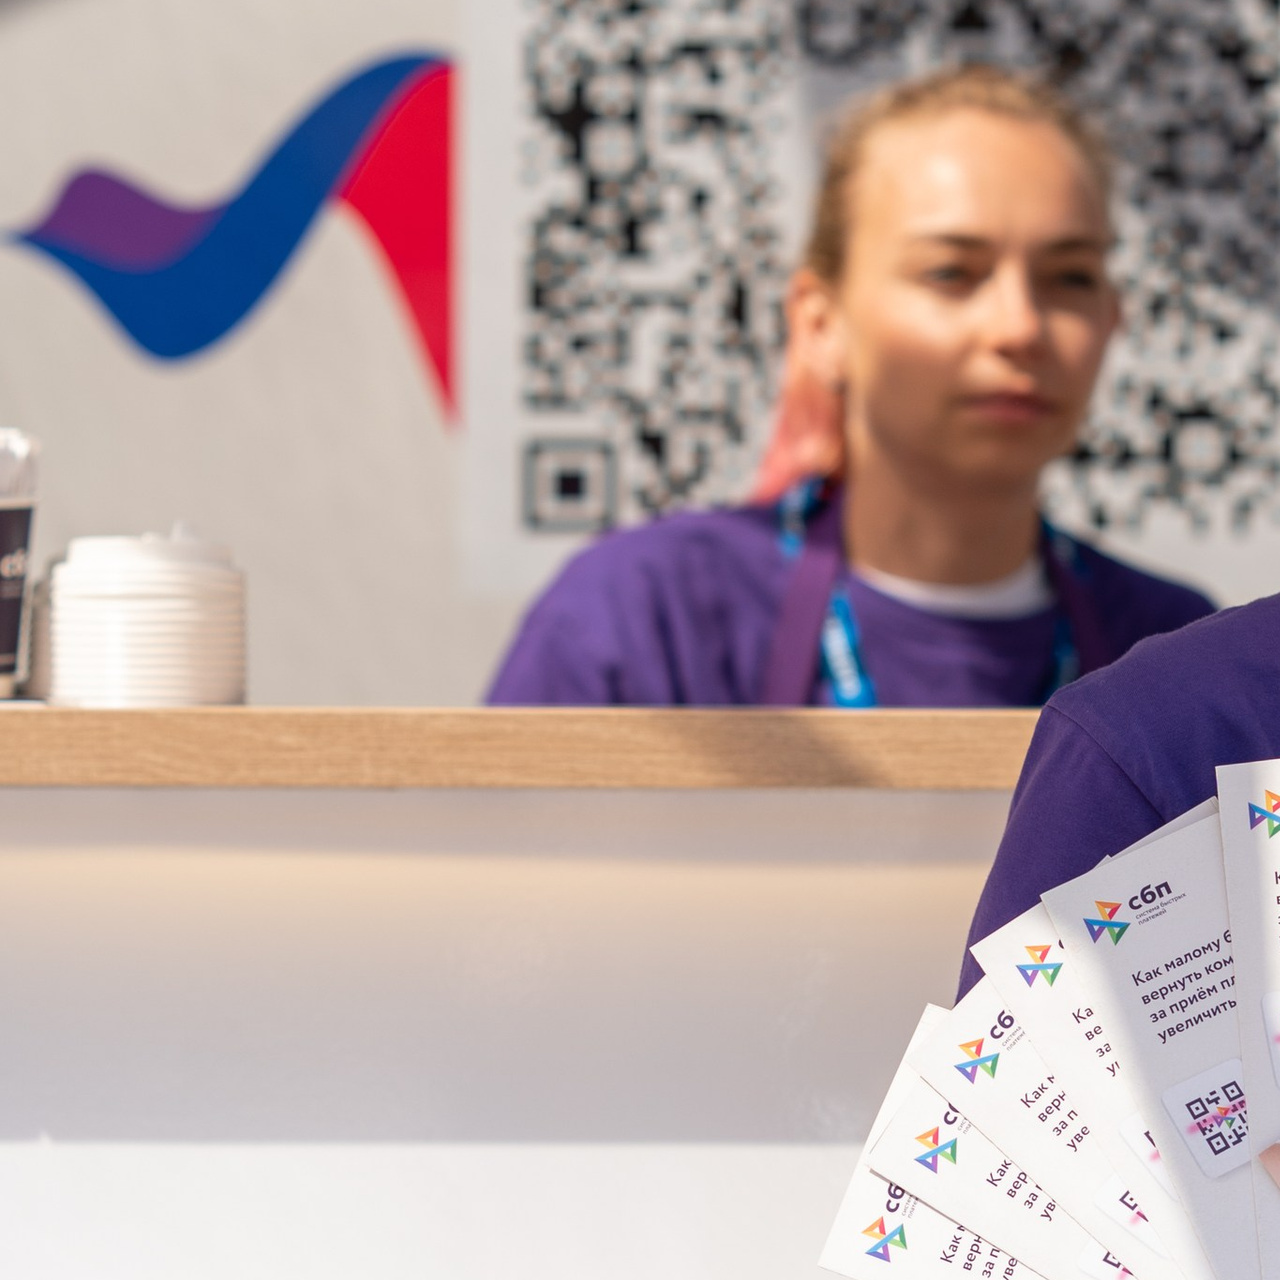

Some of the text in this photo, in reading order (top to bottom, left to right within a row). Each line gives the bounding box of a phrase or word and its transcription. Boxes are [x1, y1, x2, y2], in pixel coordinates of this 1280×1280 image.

[1128, 881, 1172, 910] сбп
[1132, 967, 1162, 987] Как
[1164, 938, 1221, 972] малому
[1141, 972, 1203, 1005] вернуть
[1072, 1006, 1094, 1024] Ка
[1150, 985, 1218, 1023] за приём
[990, 1010, 1015, 1040] сб
[1158, 998, 1237, 1044] увеличить
[1095, 1042, 1112, 1058] за
[1020, 1083, 1048, 1108] Как
[1038, 1091, 1066, 1123] верн
[1052, 1120, 1068, 1136] за
[986, 1159, 1012, 1187] Как
[886, 1182, 905, 1213] сб
[1024, 1192, 1038, 1209] за
[940, 1235, 963, 1263] Как
[963, 1235, 983, 1271] верн
[982, 1262, 995, 1278] за
